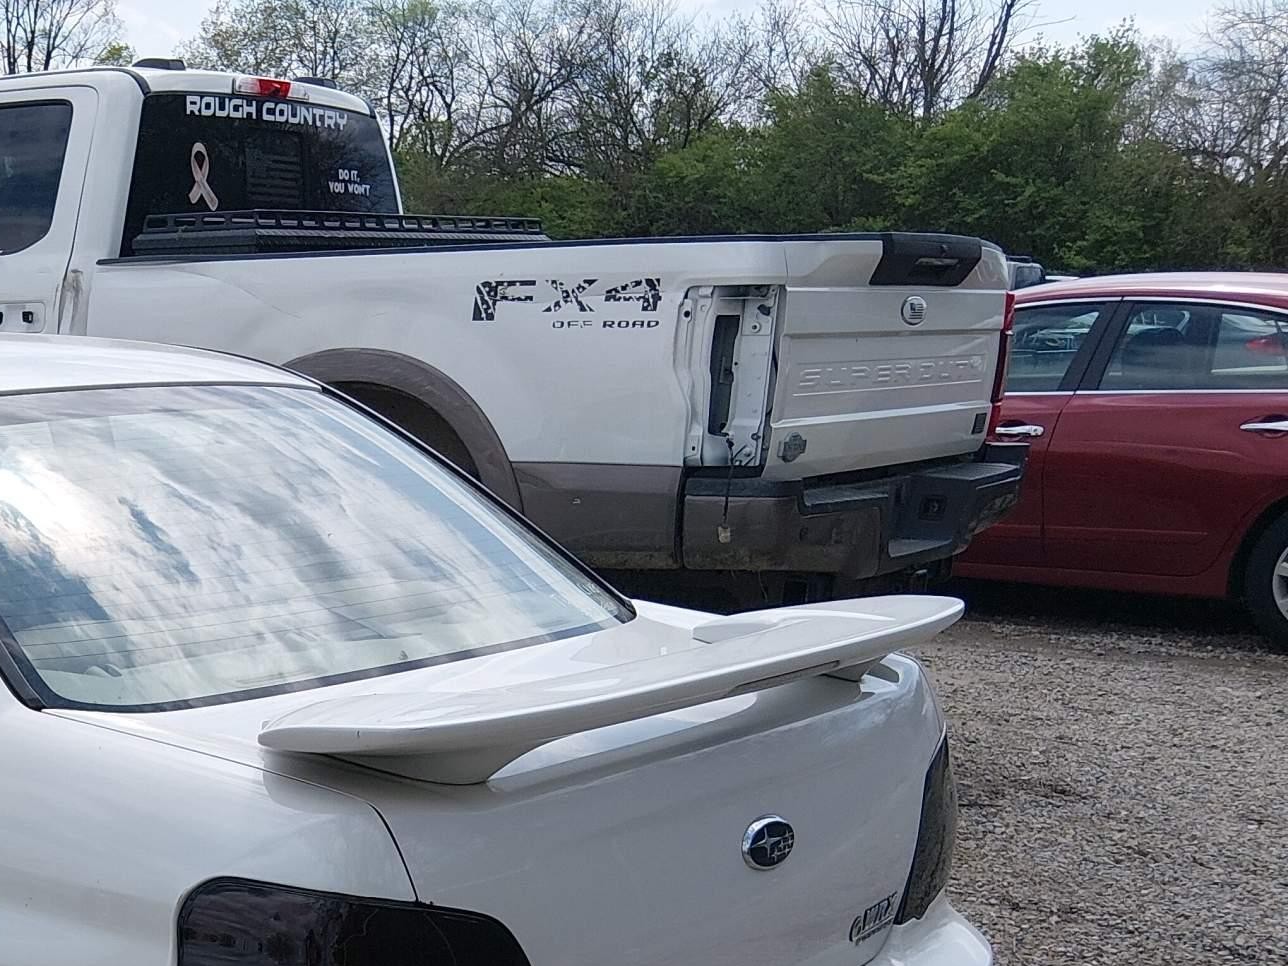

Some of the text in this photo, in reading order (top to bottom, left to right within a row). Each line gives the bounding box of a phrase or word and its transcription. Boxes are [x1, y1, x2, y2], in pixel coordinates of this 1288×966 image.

[186, 95, 347, 130] ROUGH COUNTRY
[338, 169, 360, 182] DO IT,
[328, 181, 371, 196] YOU WON'T
[472, 278, 662, 321] FX4
[552, 320, 660, 329] OFF ROAD
[799, 363, 912, 388] SUPER
[862, 891, 898, 931] WRX
